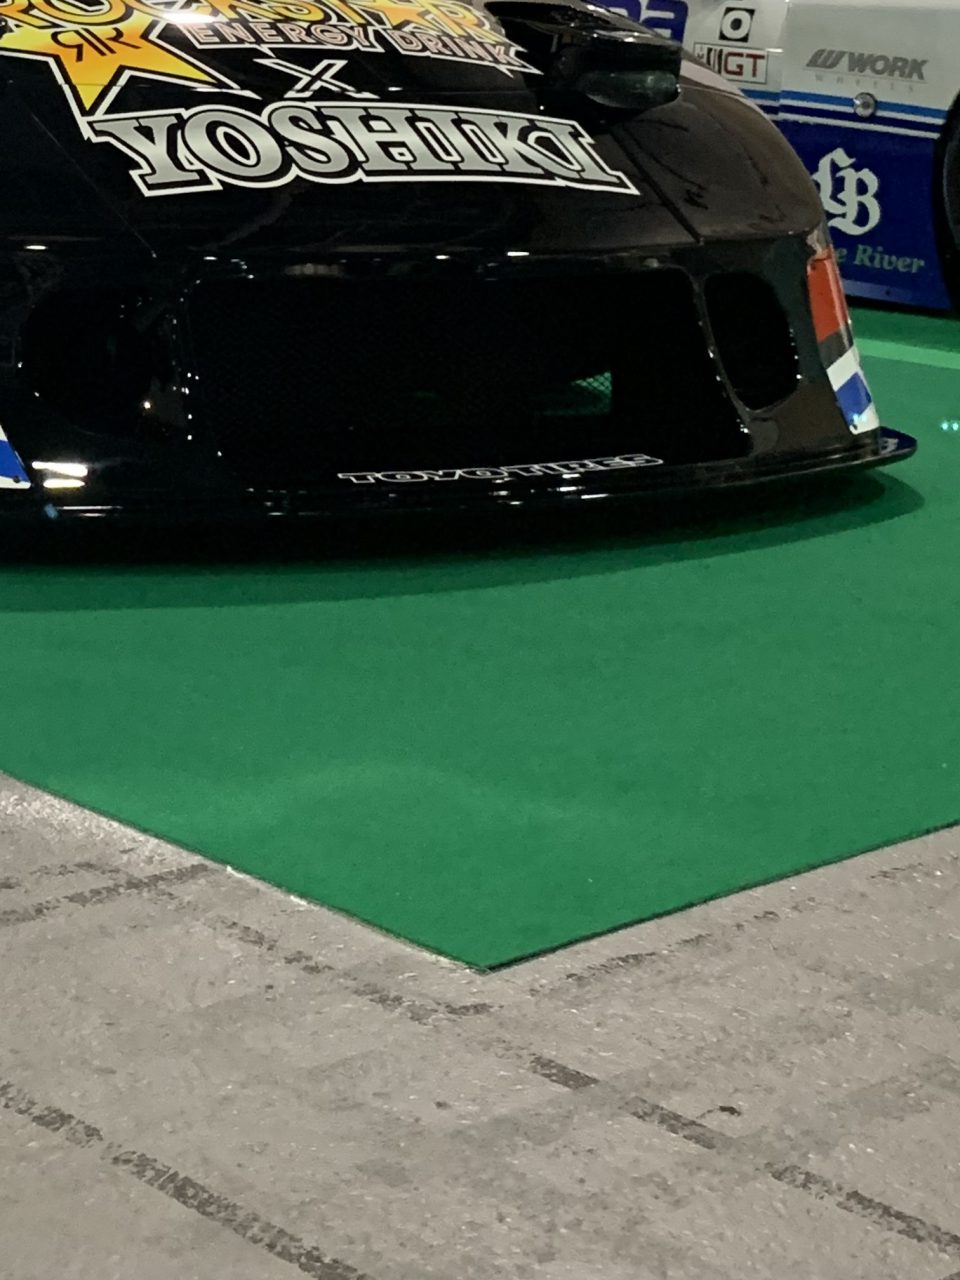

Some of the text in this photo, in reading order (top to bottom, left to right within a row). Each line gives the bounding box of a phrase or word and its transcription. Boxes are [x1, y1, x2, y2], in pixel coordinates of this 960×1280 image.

[192, 21, 520, 67] ENERGY DRINK
[253, 58, 380, 99] X
[846, 51, 928, 81] WORK
[88, 102, 640, 197] YOSHIKI
[854, 243, 926, 274] River
